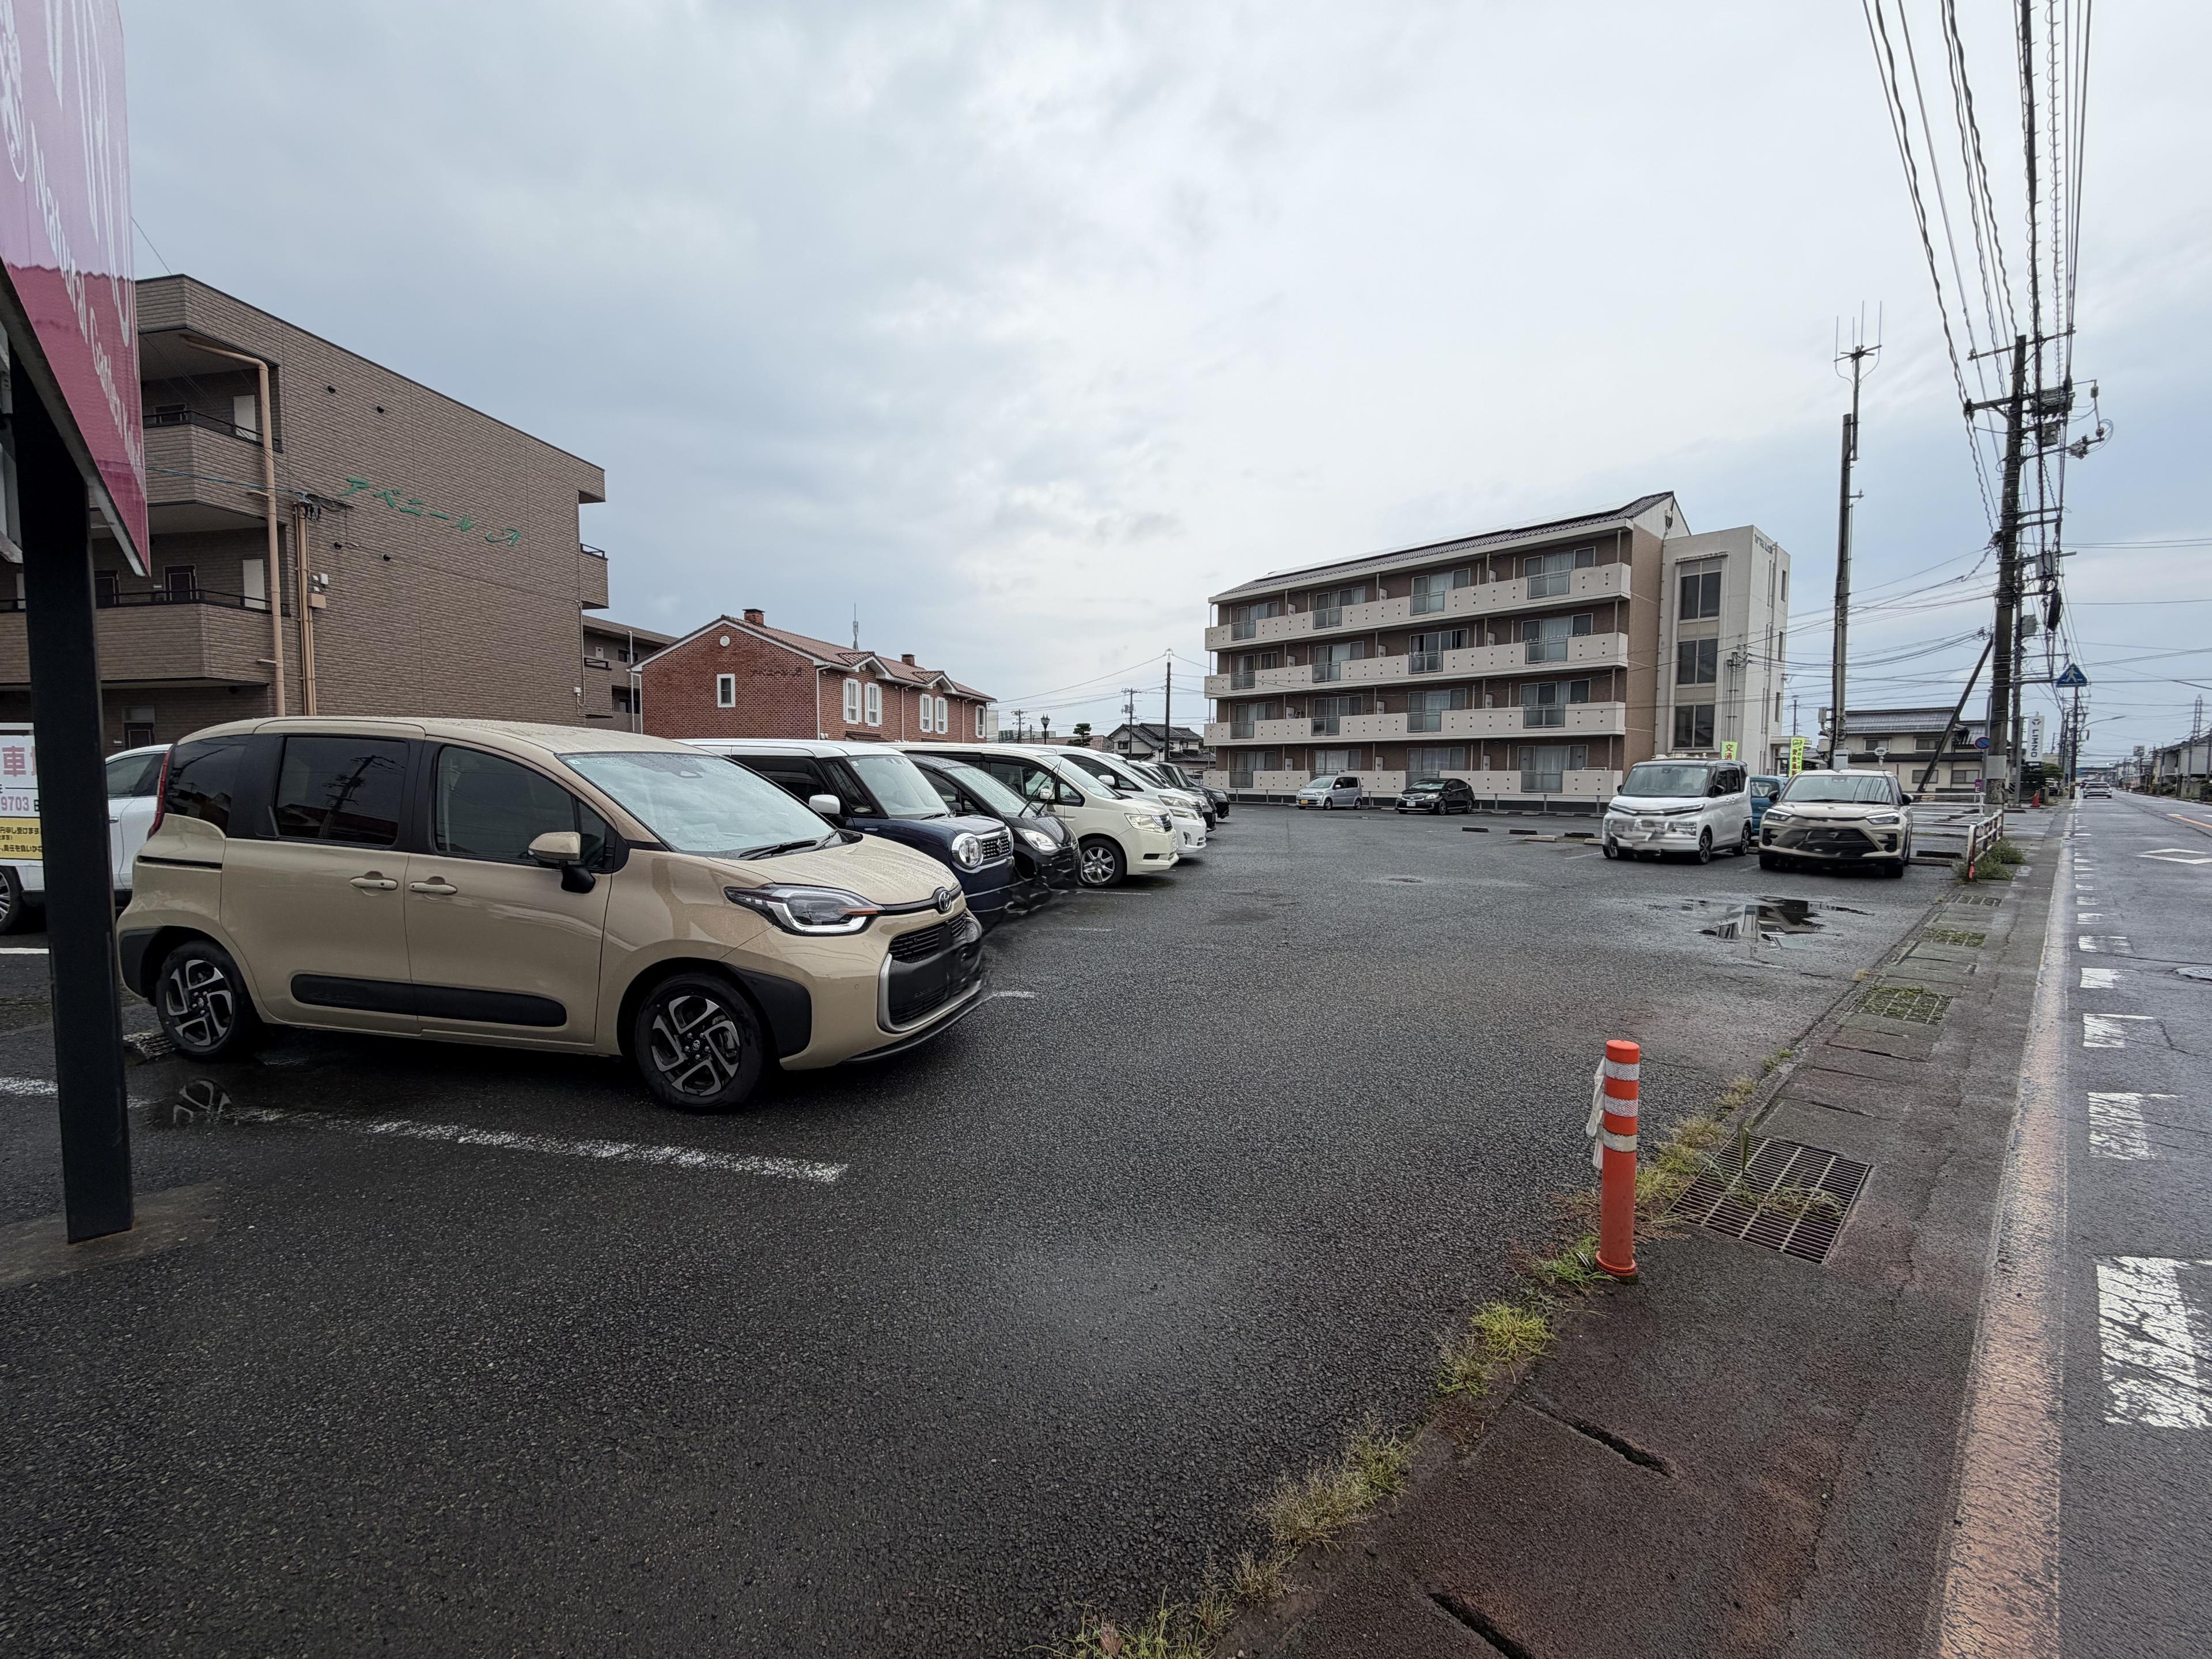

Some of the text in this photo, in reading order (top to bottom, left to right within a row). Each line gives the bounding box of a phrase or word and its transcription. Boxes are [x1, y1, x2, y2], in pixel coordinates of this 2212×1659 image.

[31, 119, 88, 345] Natural
[2031, 729, 2039, 757] LIMNO
[1, 796, 29, 811] 9703
